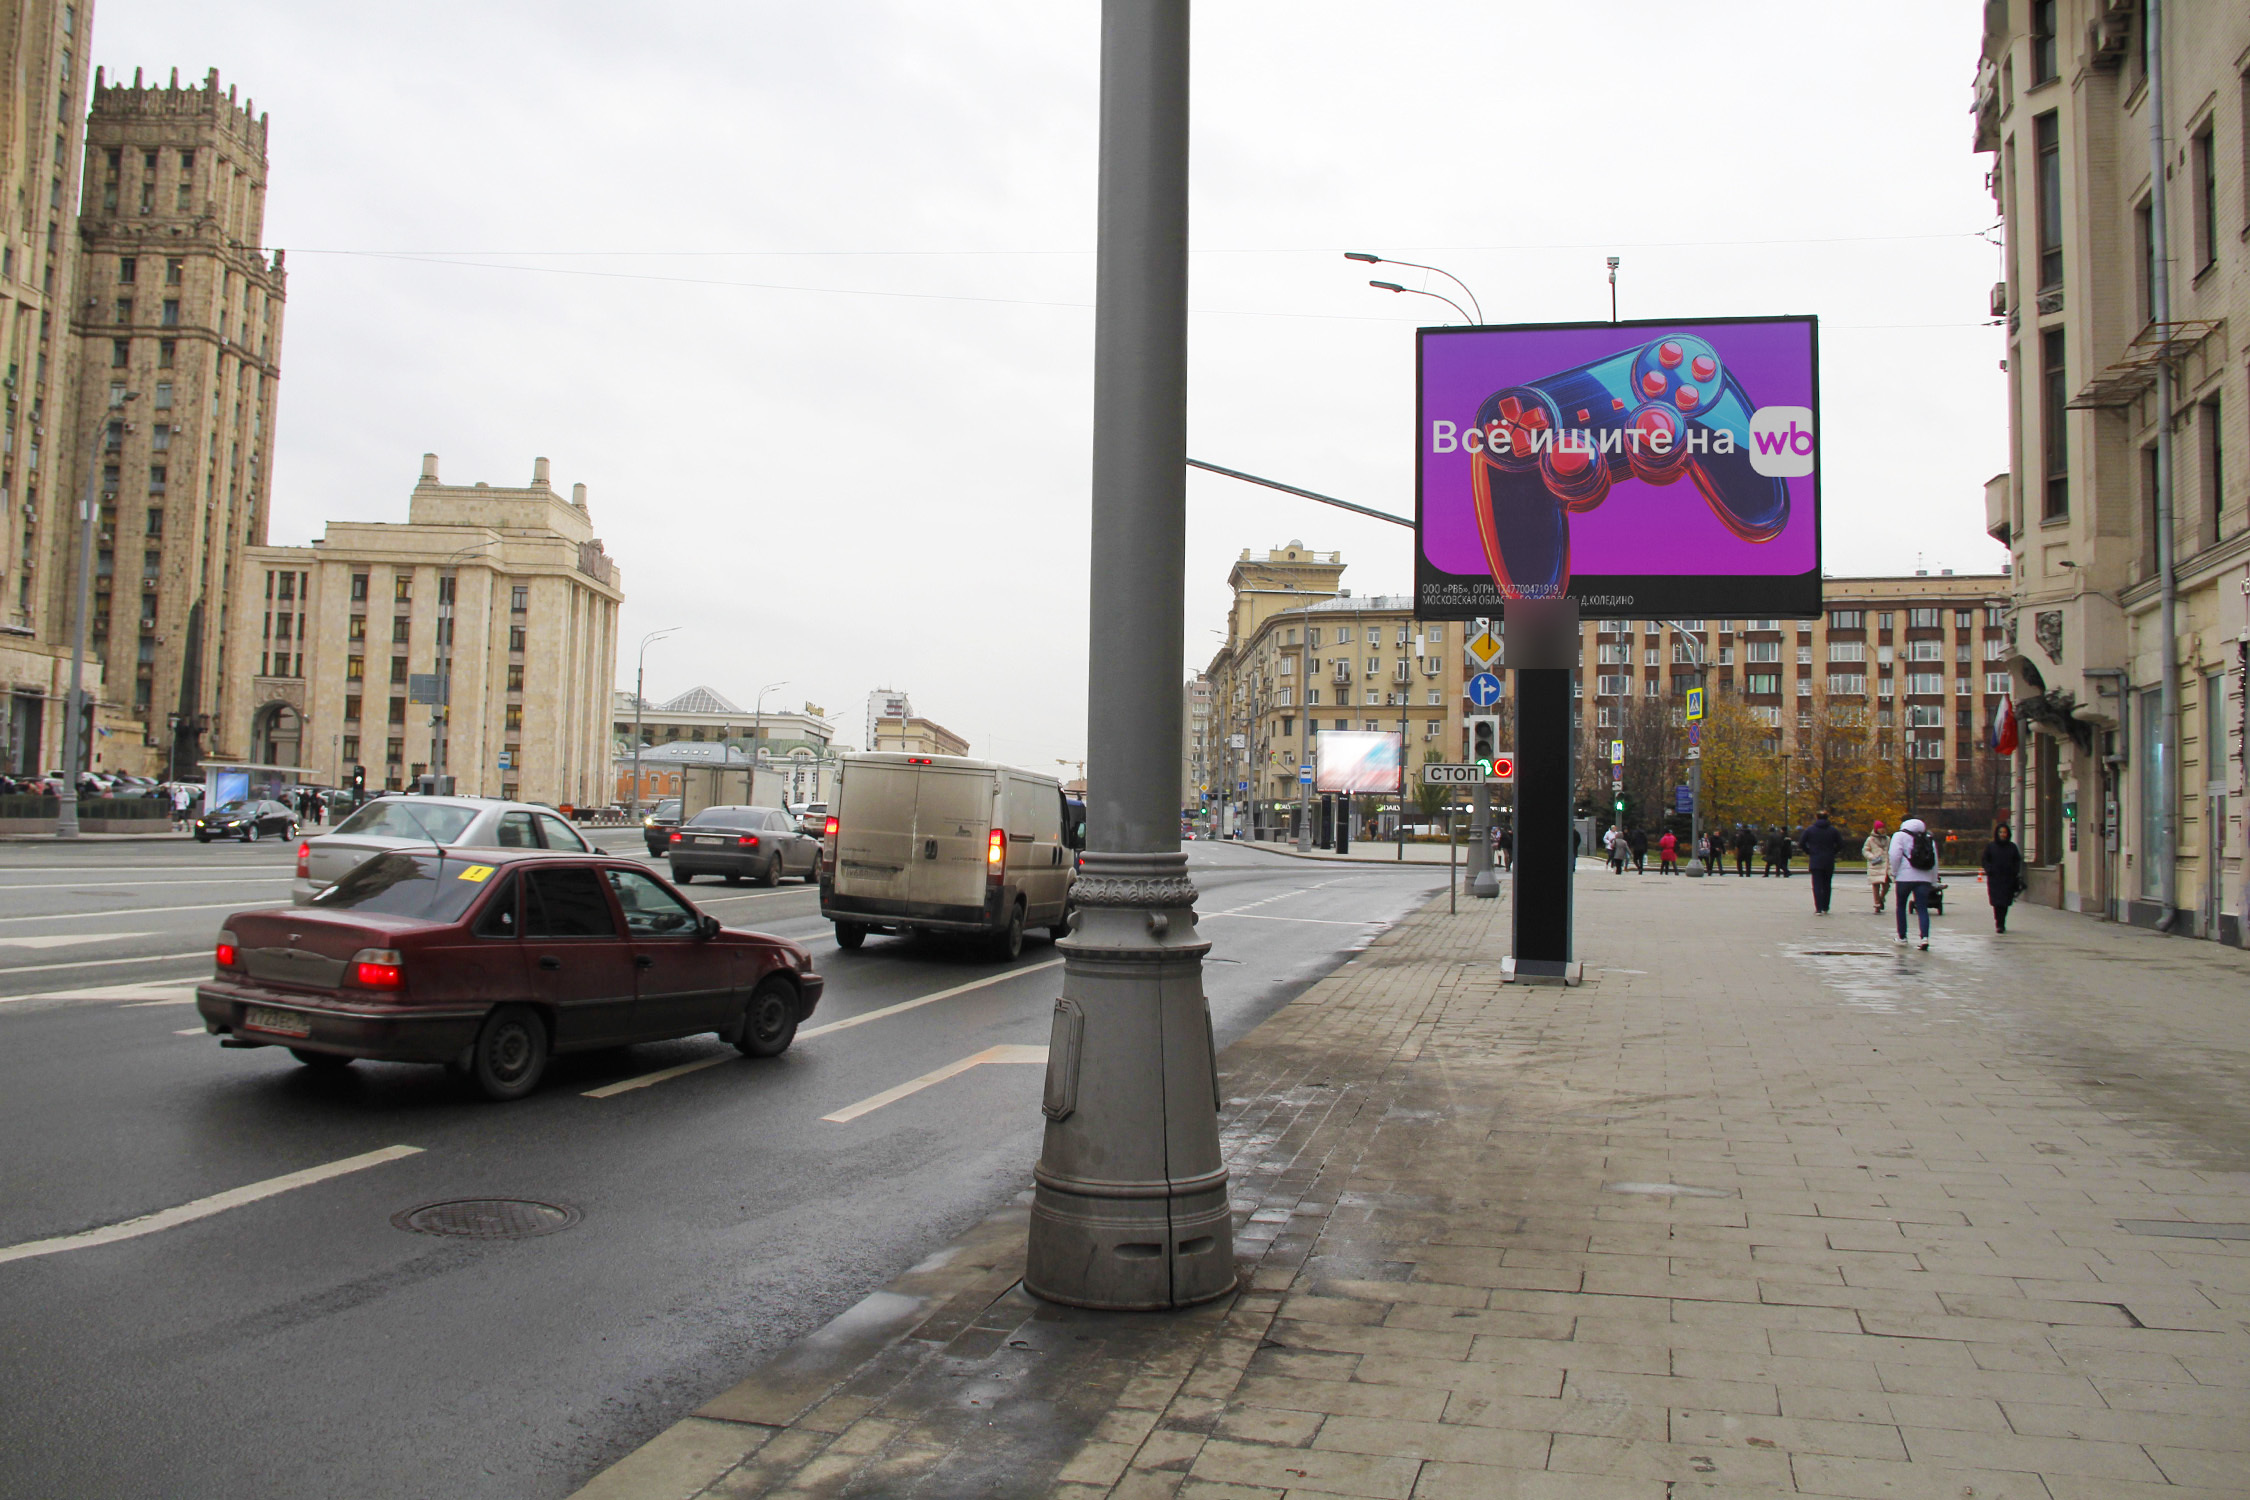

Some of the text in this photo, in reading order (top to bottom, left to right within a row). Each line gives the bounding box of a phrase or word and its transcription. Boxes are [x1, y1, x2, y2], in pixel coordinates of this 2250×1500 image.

[1432, 418, 1735, 460] Всё ищите на
[1753, 420, 1814, 456] wb
[1422, 583, 1440, 594] ООО
[1473, 583, 1494, 594] ОГРН
[1422, 595, 1477, 605] МОСКОВСКАЯ
[1581, 595, 1634, 606] Д.КОЛЕДИНО
[1431, 767, 1478, 781] СТОП
